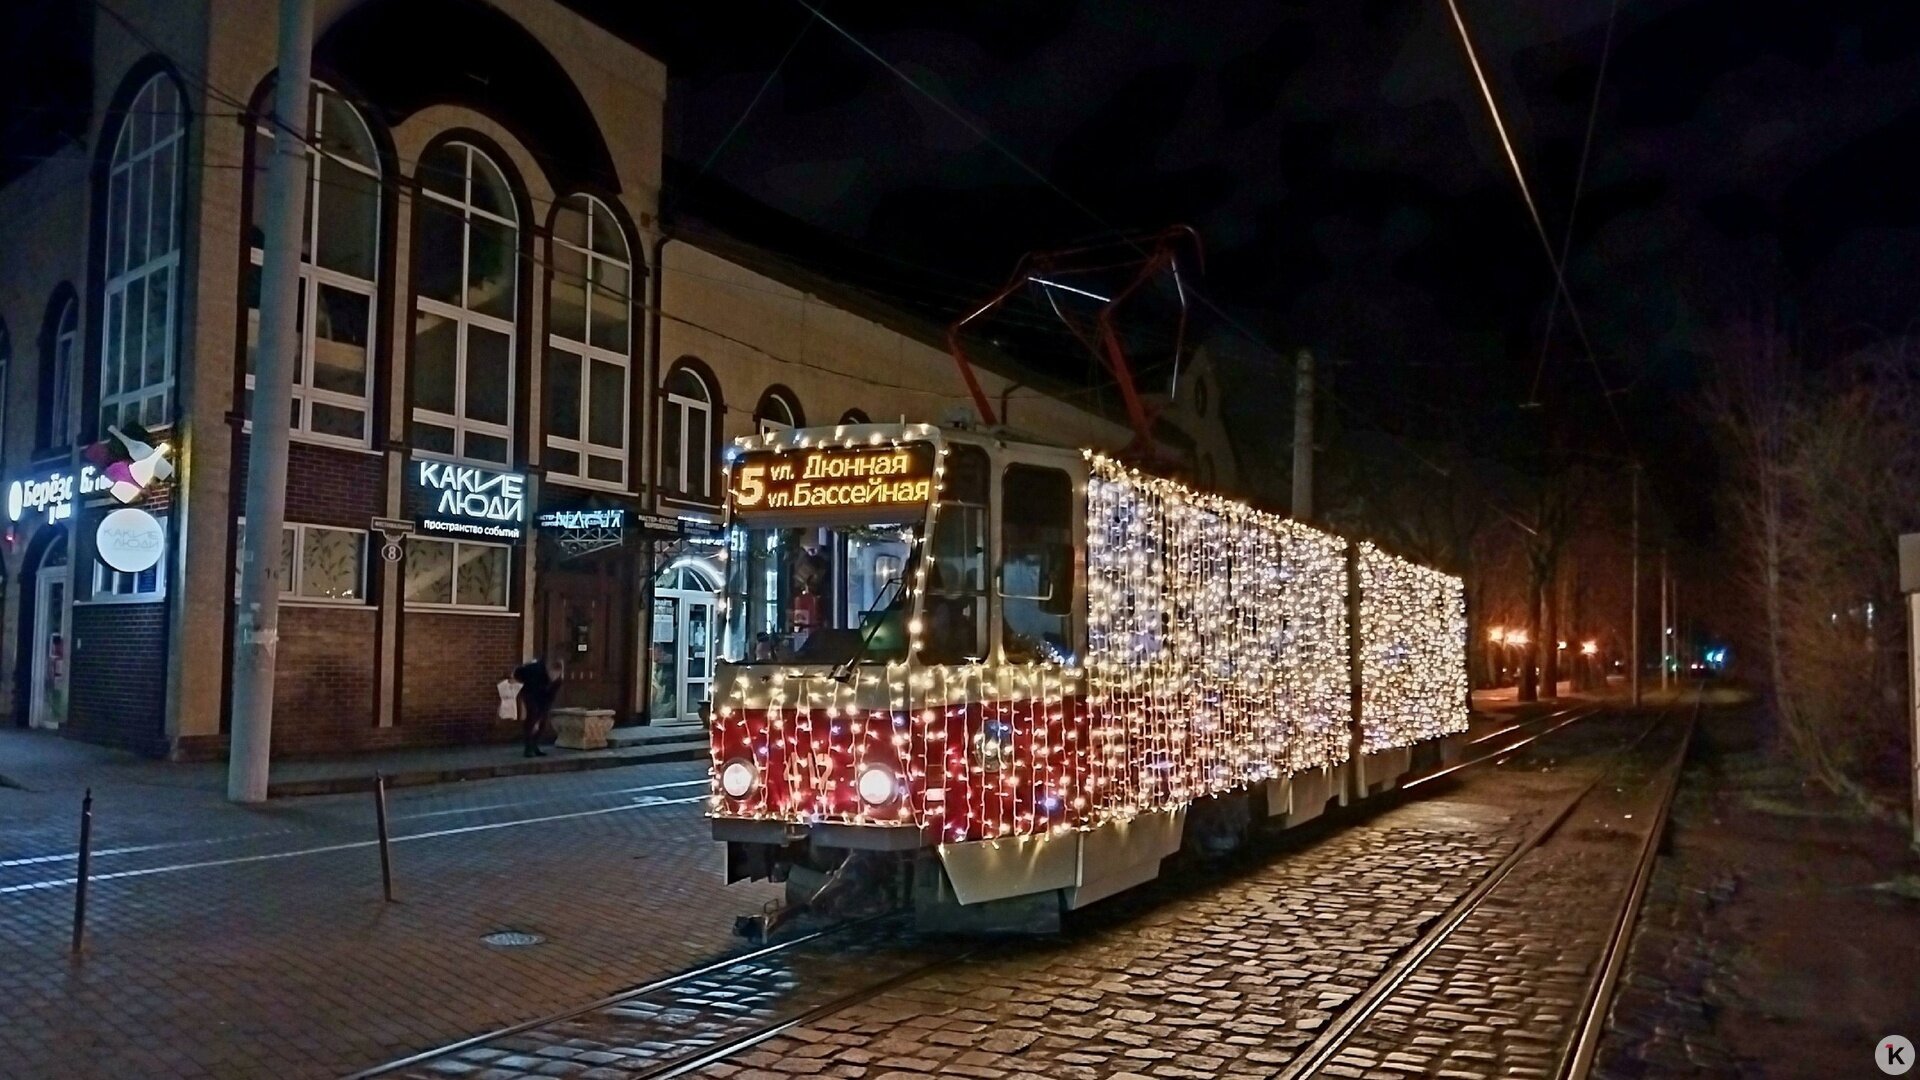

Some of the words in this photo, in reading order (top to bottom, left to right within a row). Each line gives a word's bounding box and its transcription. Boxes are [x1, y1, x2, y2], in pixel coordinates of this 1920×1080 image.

[420, 461, 524, 500] КАКИЕ
[738, 467, 766, 506] 5
[770, 464, 795, 481] ул.
[803, 454, 908, 480] Дюнная
[437, 488, 523, 522] ЛЮДИ
[484, 525, 520, 538] событий
[388, 546, 396, 560] 8
